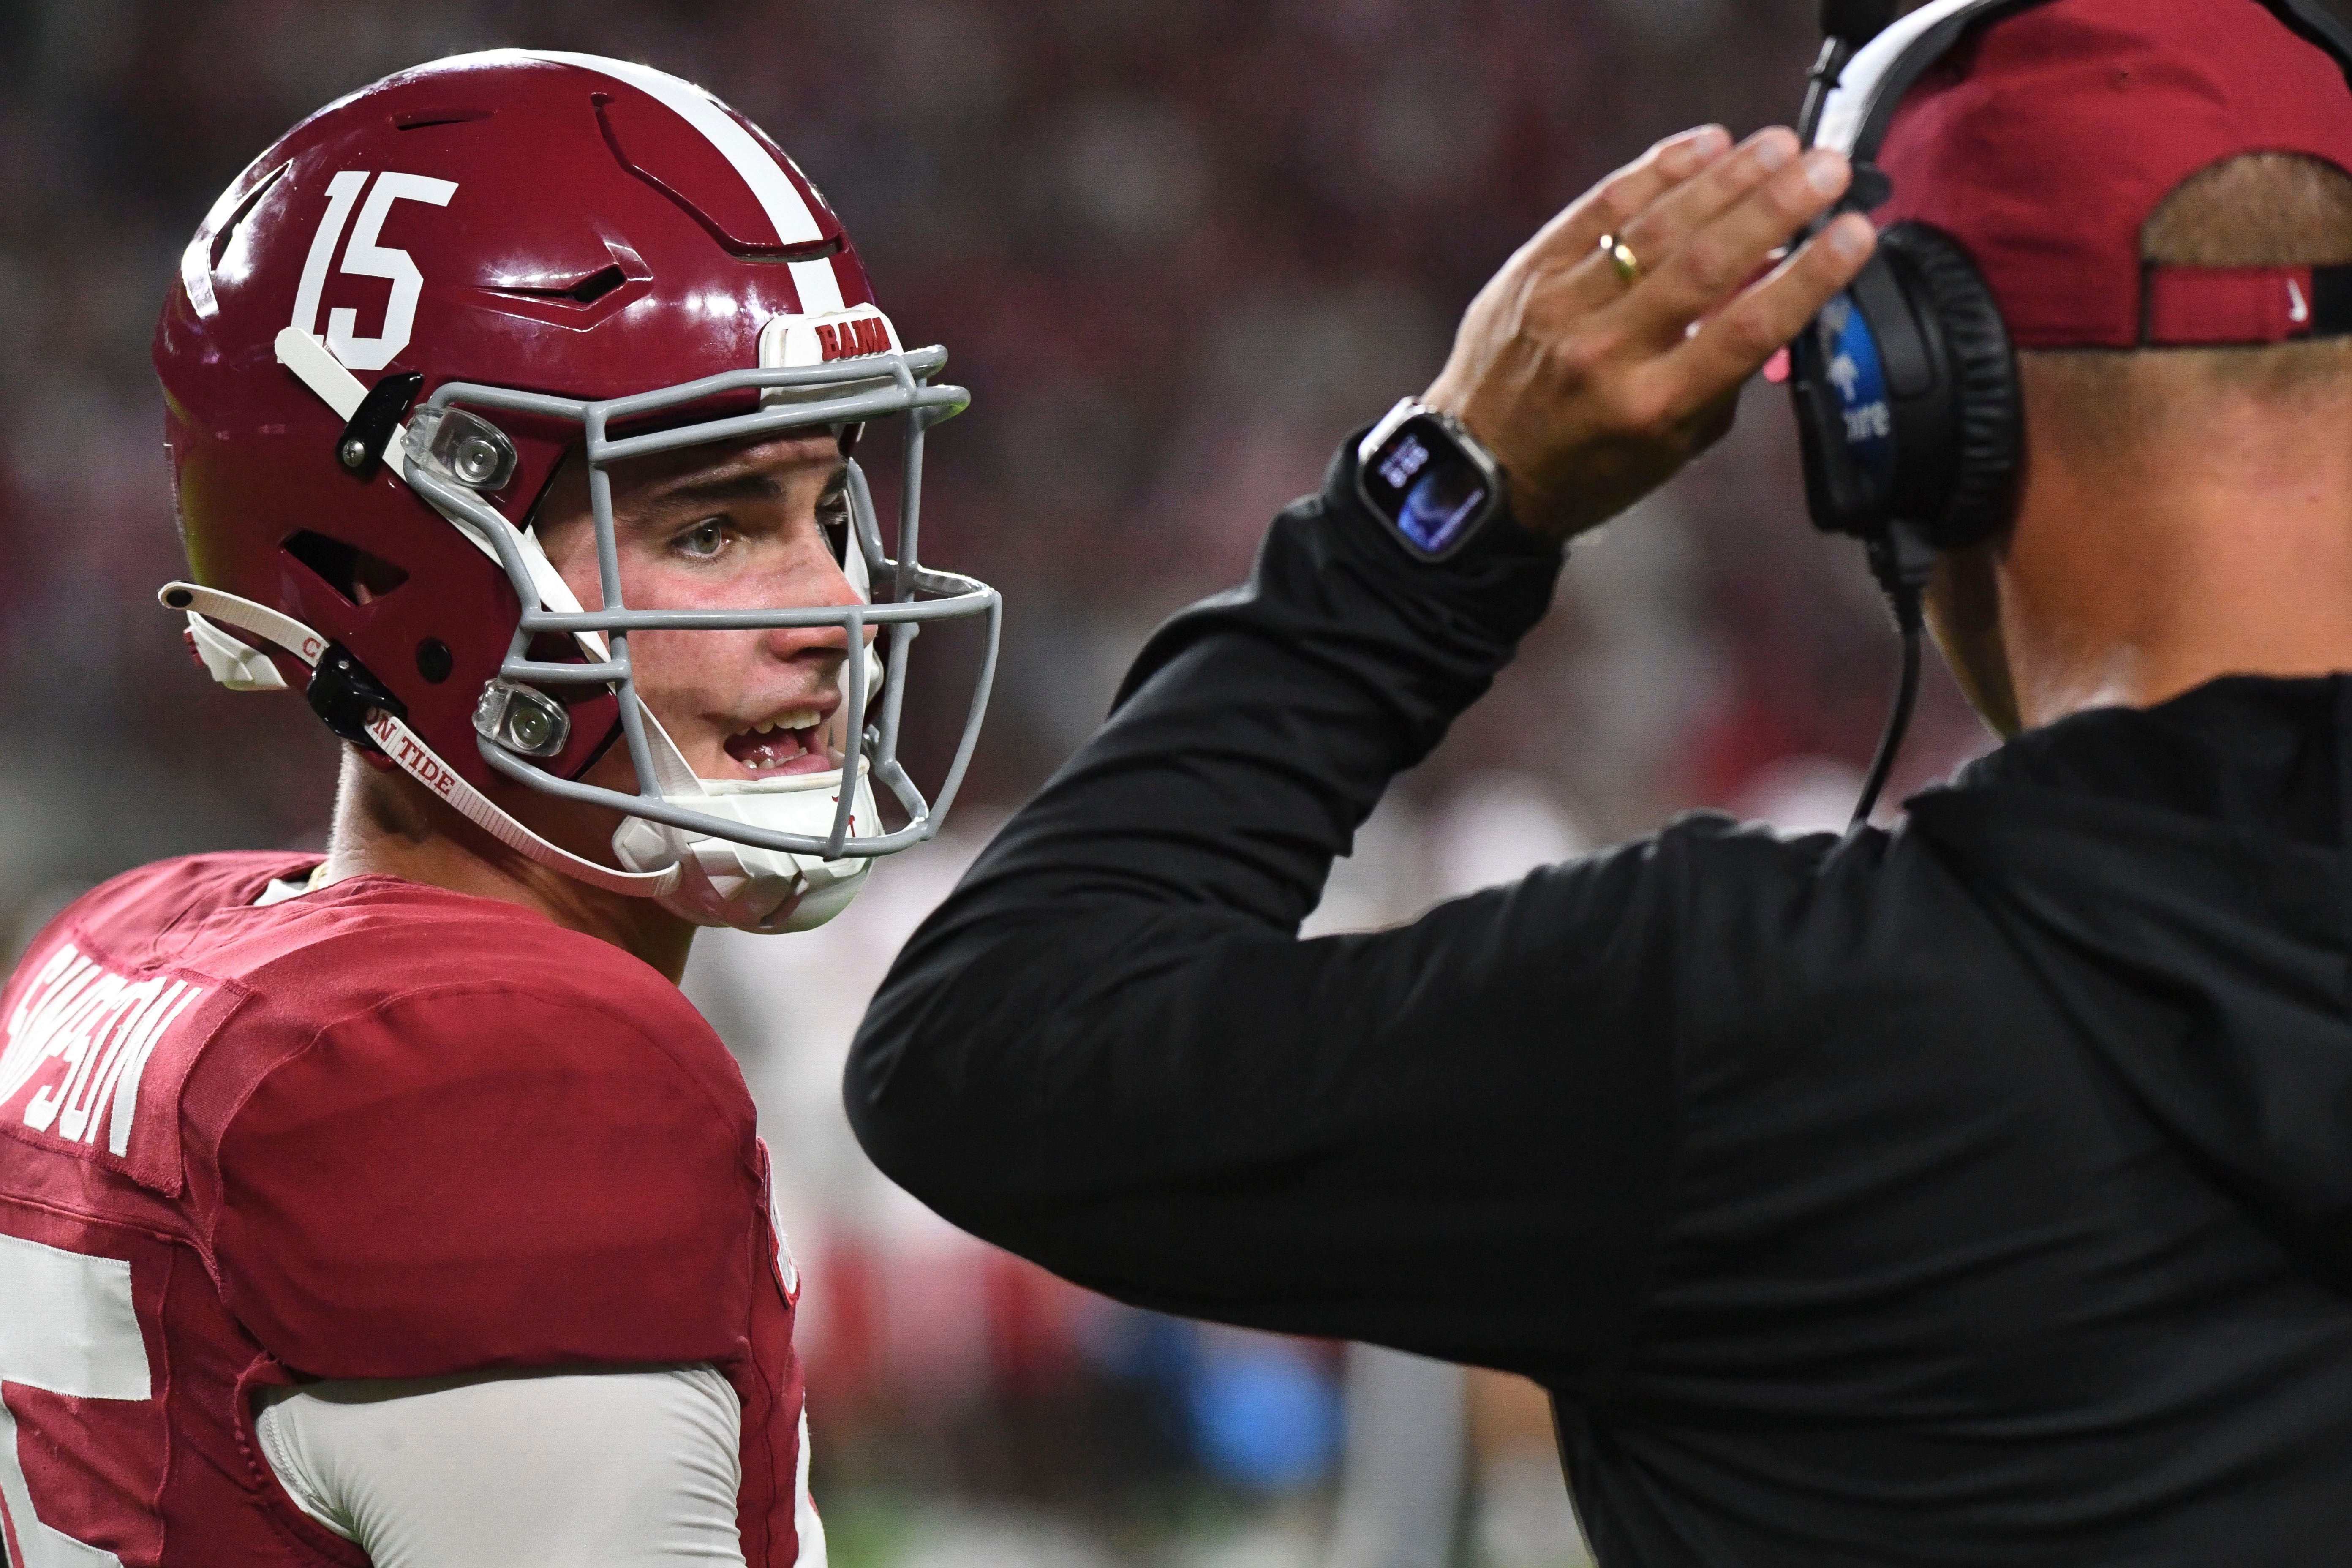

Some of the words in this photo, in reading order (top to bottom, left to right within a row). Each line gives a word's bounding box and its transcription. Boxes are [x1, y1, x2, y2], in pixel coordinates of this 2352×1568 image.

[277, 171, 459, 370] 15
[815, 317, 892, 361] BAMA
[398, 736, 456, 796] TIDE
